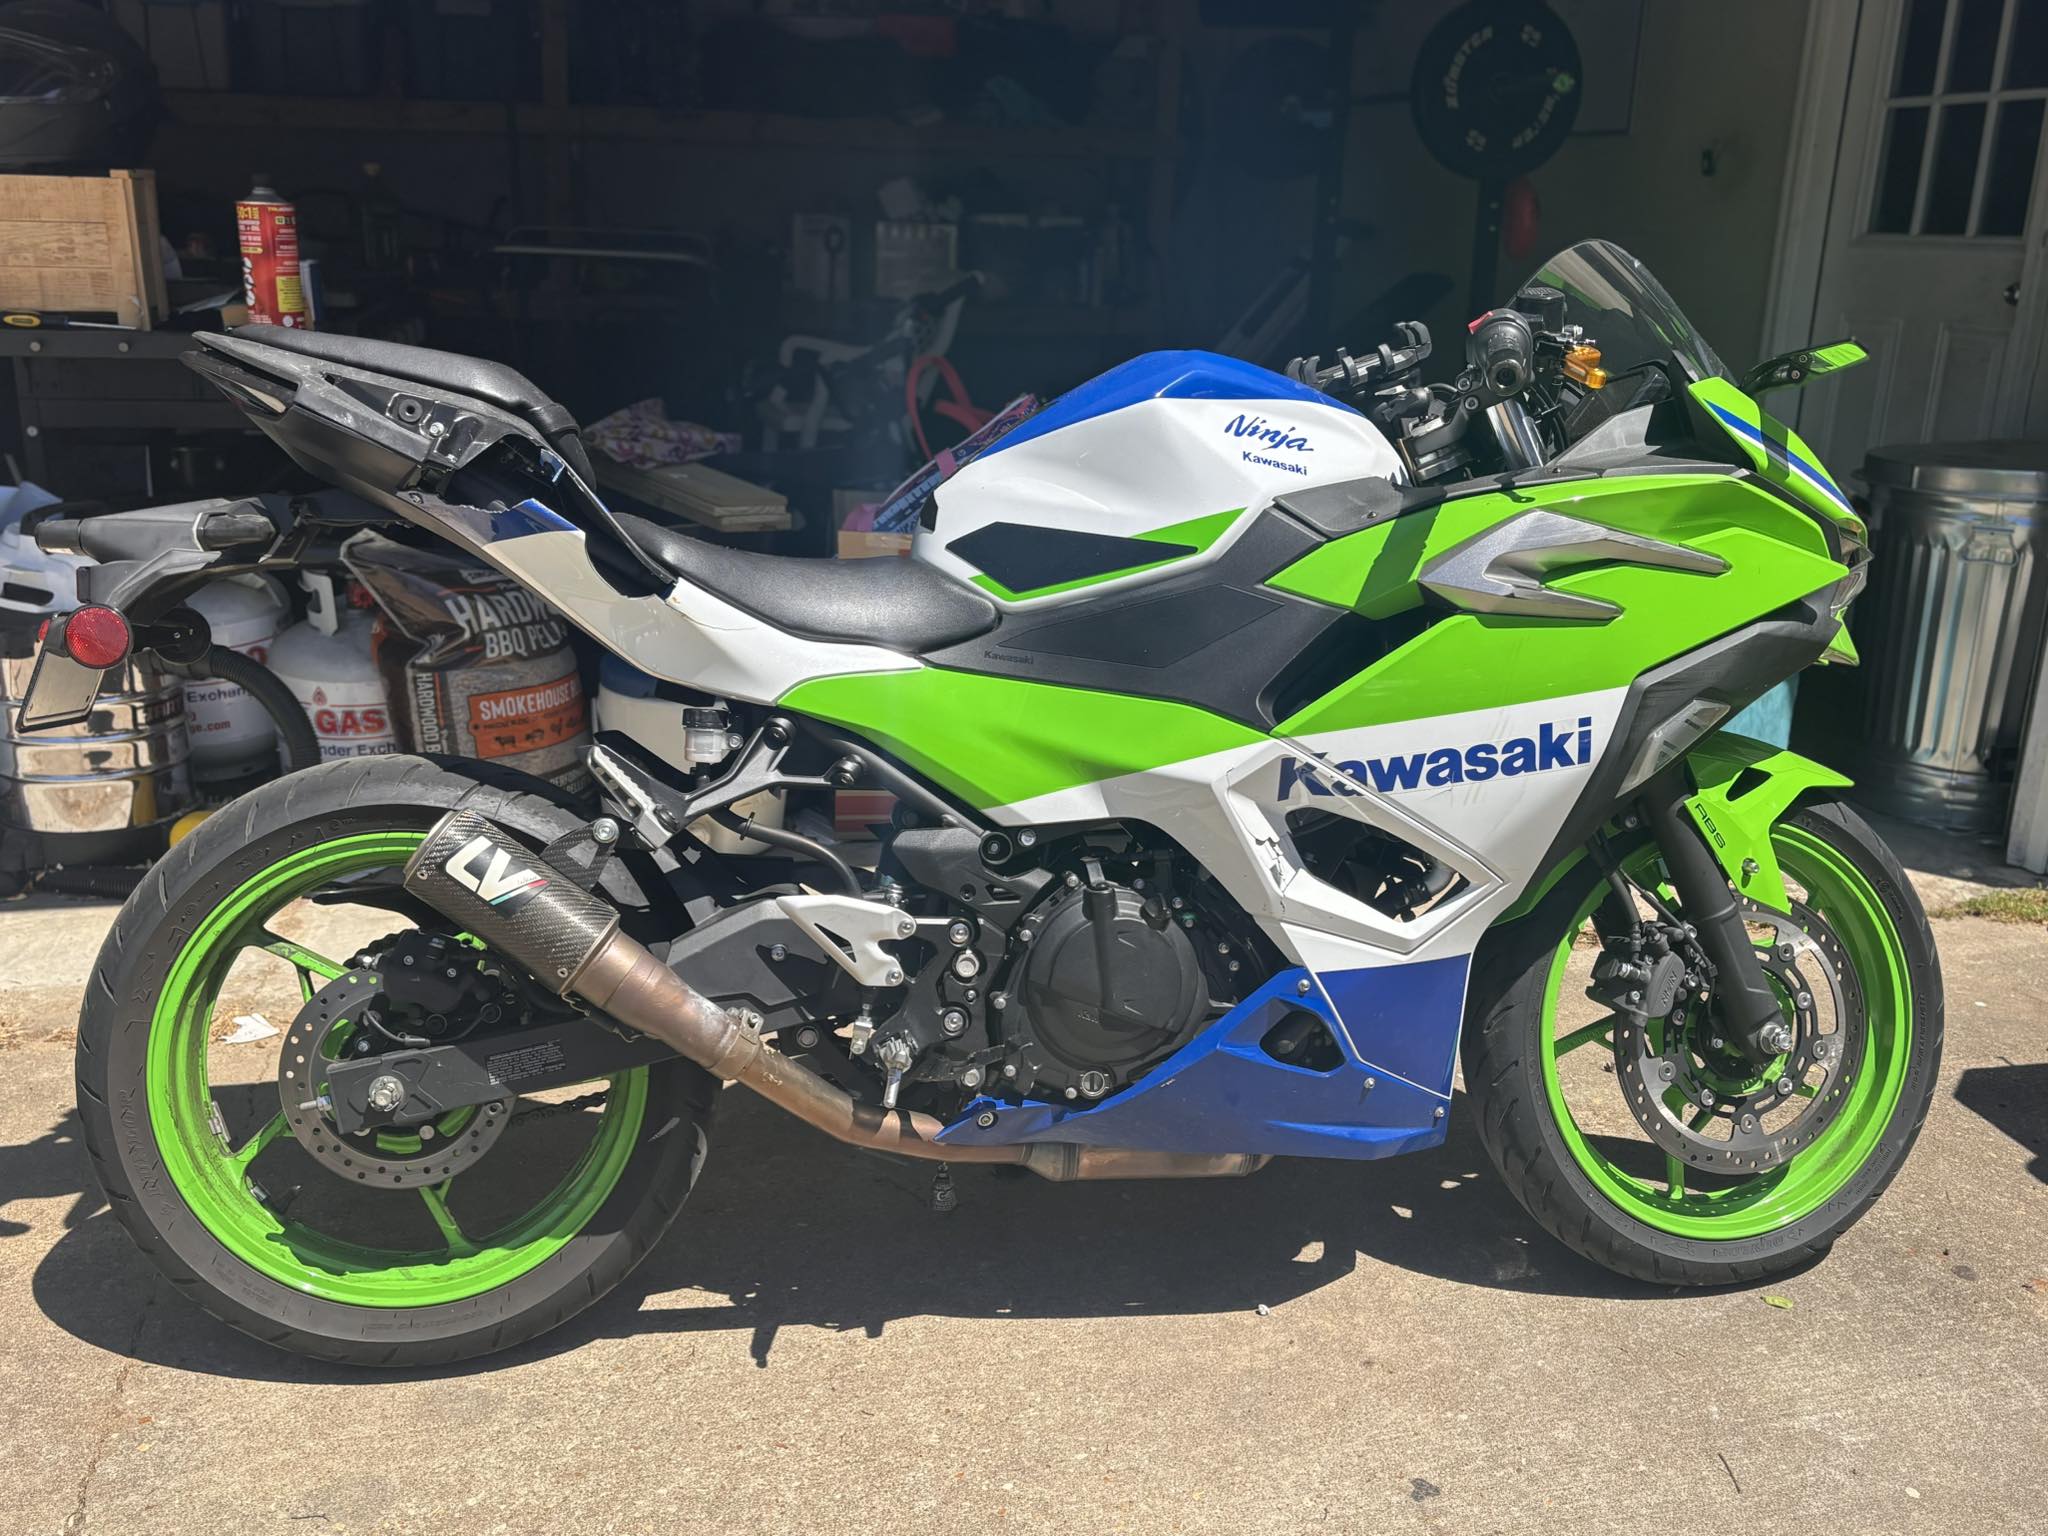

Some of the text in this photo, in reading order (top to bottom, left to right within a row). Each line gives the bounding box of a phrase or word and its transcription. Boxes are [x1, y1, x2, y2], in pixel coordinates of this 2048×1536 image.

[1224, 414, 1314, 451] Ninja
[1243, 451, 1307, 476] Kawasaki
[484, 628, 528, 659] BBQ
[984, 650, 1033, 664] Kawasaki
[416, 672, 440, 742] HARDWOOD
[479, 683, 570, 721] SMOKEHOUSE
[315, 709, 386, 735] GAS
[1277, 716, 1592, 801] Kawasaki
[1695, 803, 1726, 848] ABS
